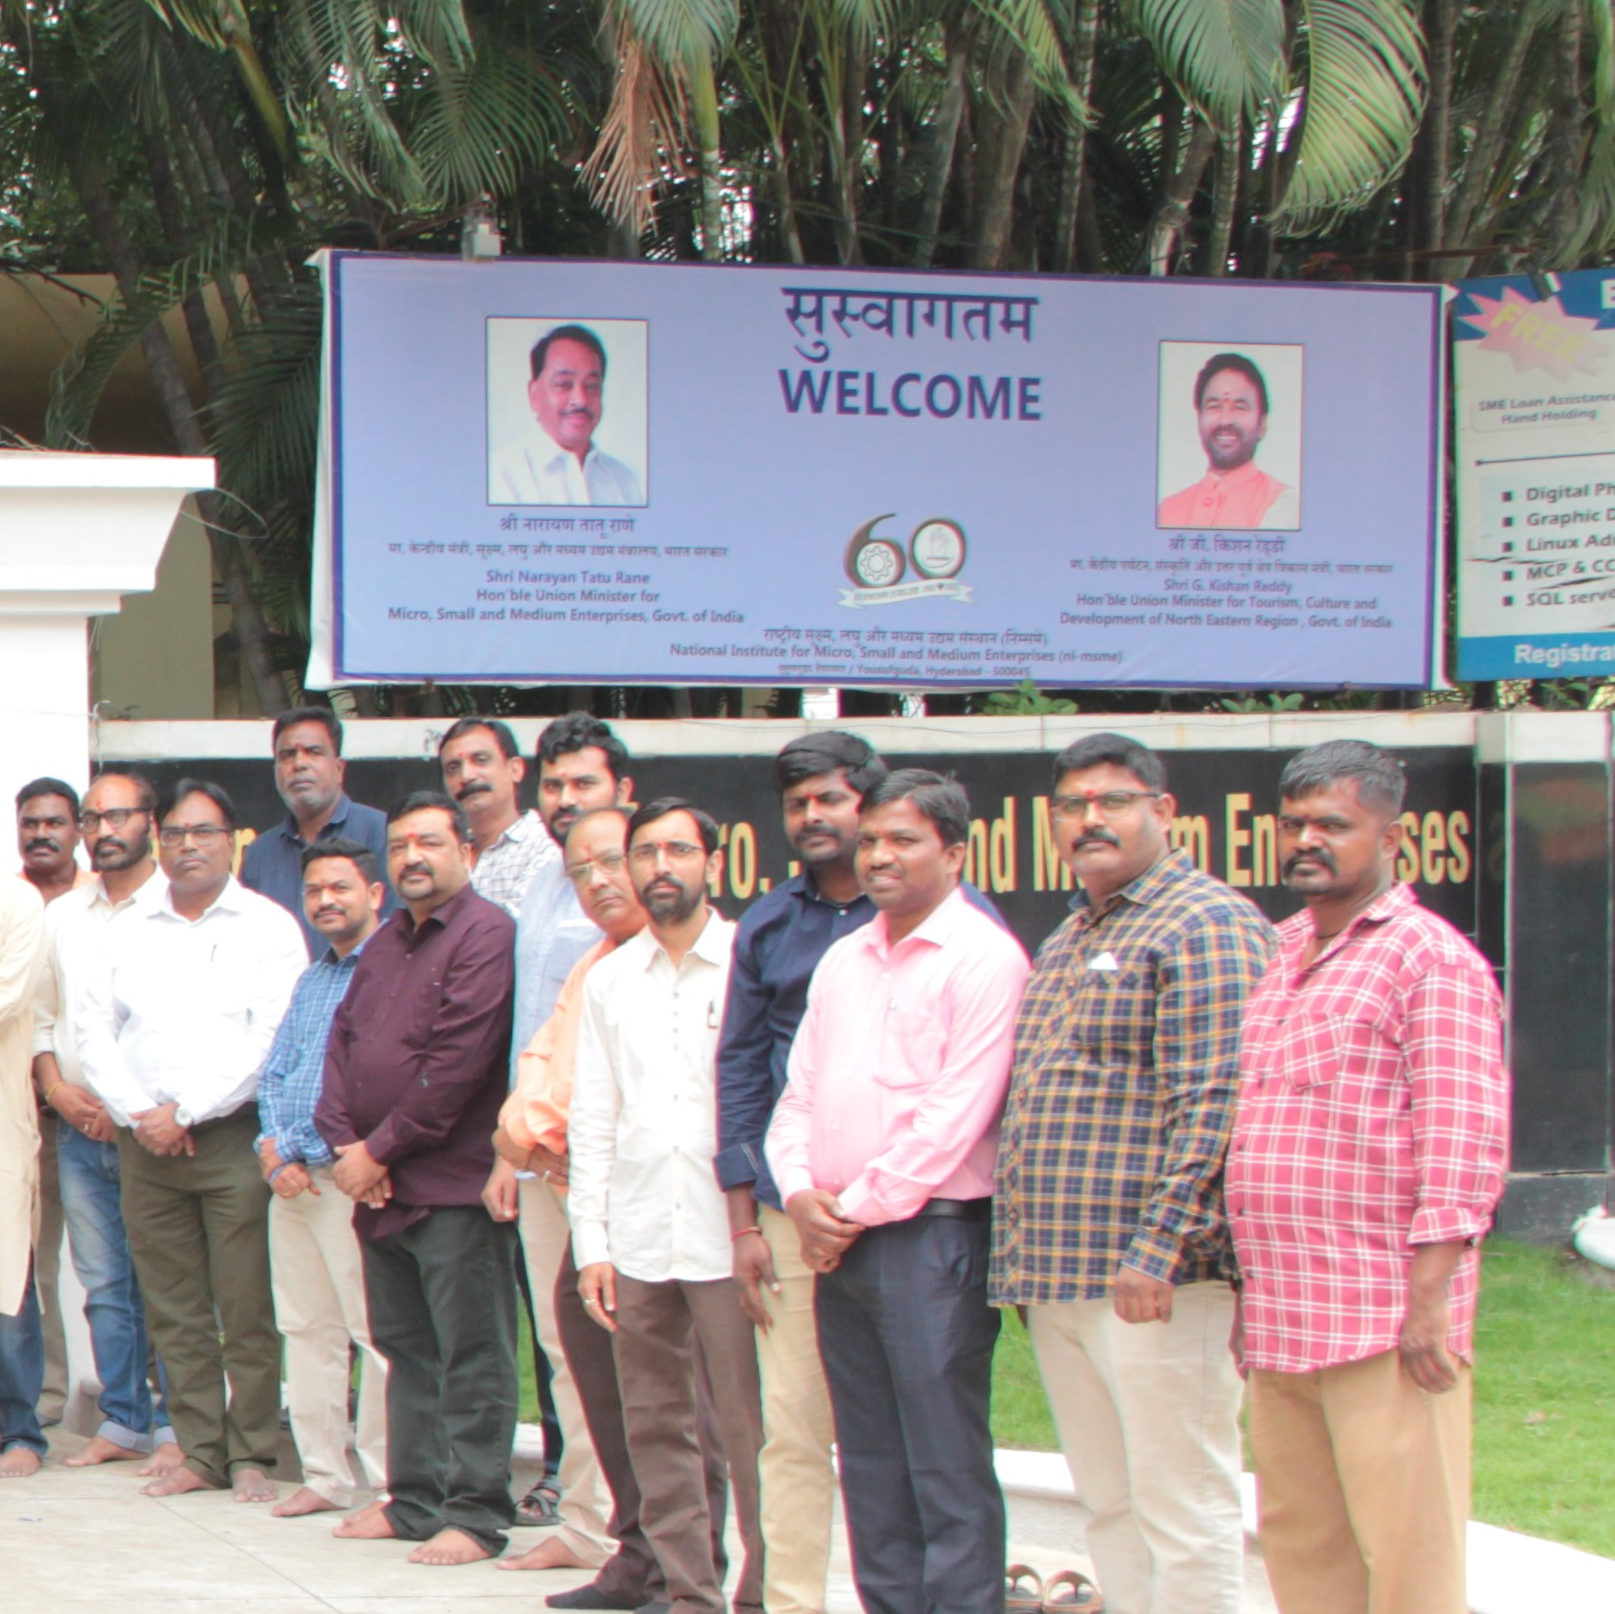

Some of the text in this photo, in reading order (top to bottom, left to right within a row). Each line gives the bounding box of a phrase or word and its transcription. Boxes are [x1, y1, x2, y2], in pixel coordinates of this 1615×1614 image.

[781, 287, 1040, 363] सुस्वागतम
[1491, 303, 1588, 363] FREE
[778, 369, 1042, 421] WELCOME
[1478, 400, 1506, 411] SME
[1510, 398, 1543, 409] Loan
[1502, 409, 1596, 424] Hand Holding
[1526, 484, 1589, 504] Digital
[500, 513, 635, 539] श्री नारायण तातू राणे
[1527, 509, 1600, 528] Graphic
[532, 540, 552, 555] और
[664, 546, 692, 557] भारत
[694, 547, 728, 558] सरकार
[843, 513, 966, 588] 60
[1169, 534, 1185, 551] श्री
[1213, 534, 1252, 552] किशन
[1527, 539, 1578, 552] Linux
[486, 570, 650, 586] Shri Narayan Tatu Rane
[1527, 563, 1567, 580] MCP
[1573, 561, 1585, 573] &
[536, 589, 575, 602] Union
[580, 588, 636, 602] Minister
[640, 588, 660, 602] for
[1164, 579, 1291, 595] Shri G. Kishan Reddy
[1130, 594, 1167, 606] Union
[1172, 595, 1223, 607] Minister
[1227, 595, 1245, 607] for
[1249, 596, 1302, 610] Tourism,
[1306, 597, 1350, 609] Culture
[1353, 598, 1376, 610] and
[1527, 592, 1563, 606] SQL
[388, 608, 744, 624] Micro, Small and Medium Enterprises, Govt. of India
[1060, 612, 1144, 626] Development
[1149, 612, 1162, 625] of
[1165, 613, 1202, 625] North
[1206, 614, 1251, 626] Eastern
[1255, 615, 1297, 629] Region
[1308, 615, 1341, 627] Govt.
[1345, 616, 1357, 628] of
[1361, 616, 1391, 629] India
[866, 626, 886, 642] और
[670, 644, 1122, 664] National Institute for Micro, Small and Medium Enterprises (ni-msme)
[1514, 644, 1615, 668] Registra
[925, 666, 981, 678] Hyderabad
[993, 667, 1029, 677] 500045
[963, 796, 1017, 893] nd
